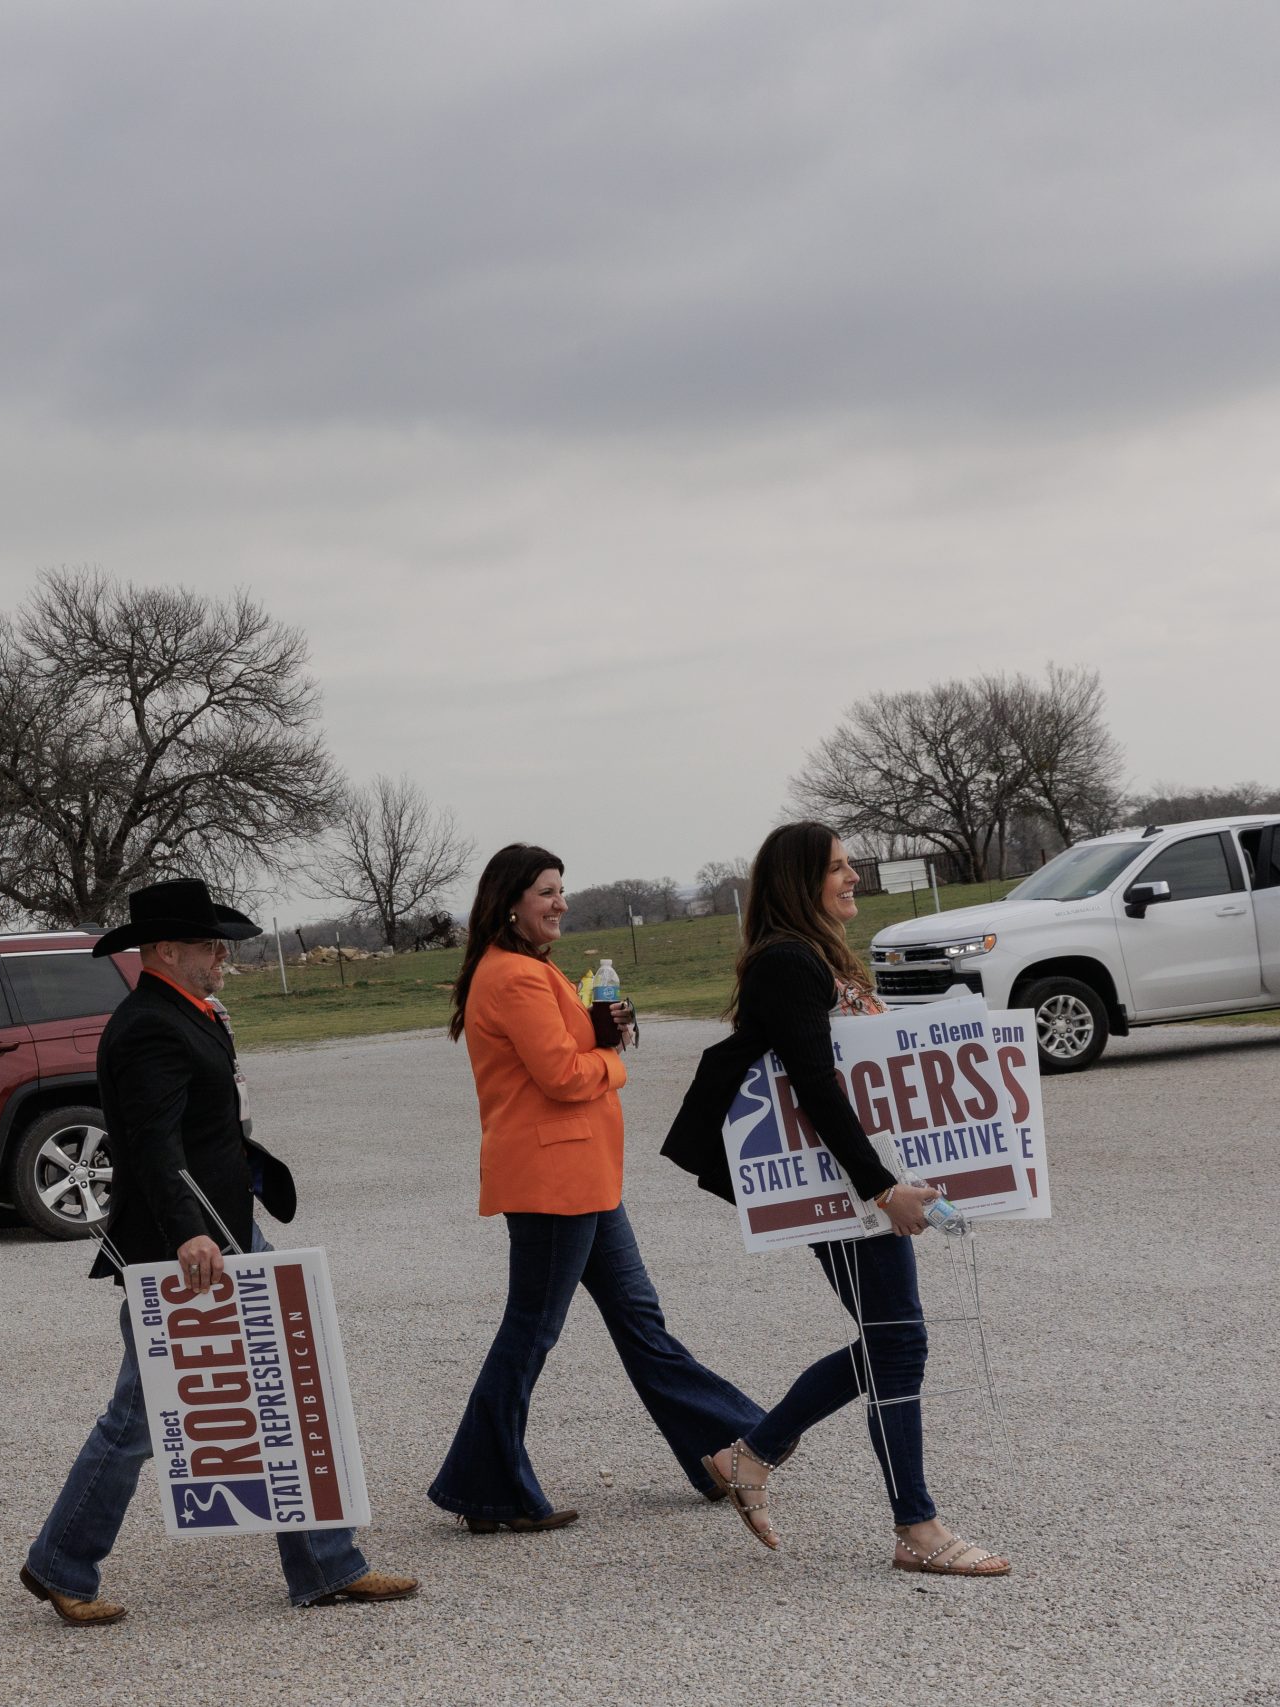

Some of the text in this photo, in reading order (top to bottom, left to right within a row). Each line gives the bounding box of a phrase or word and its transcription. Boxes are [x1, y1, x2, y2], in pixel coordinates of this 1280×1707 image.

[897, 1021, 984, 1051] Dr. Glenn
[992, 1026, 1024, 1044] enn
[739, 1156, 808, 1195] STATE
[140, 1276, 189, 1479] Re-Elect Dr. Glenn
[160, 1272, 264, 1477] ROGERS
[236, 1267, 306, 1523] STATE REPRESENTATIVE
[289, 1311, 329, 1475] REPUBLICAN
